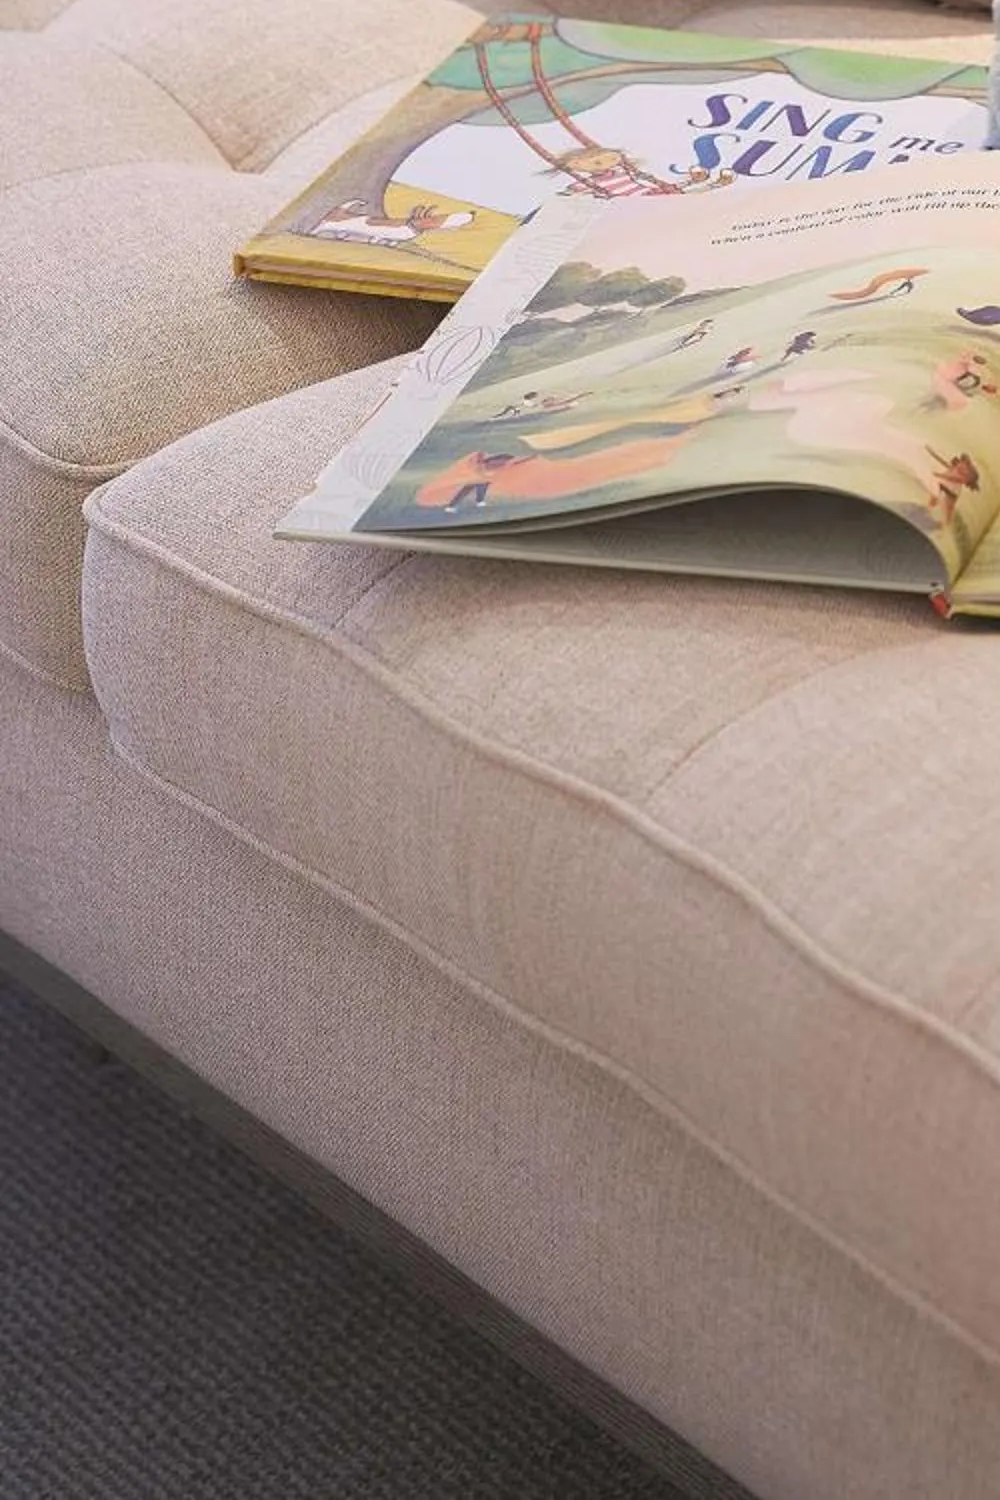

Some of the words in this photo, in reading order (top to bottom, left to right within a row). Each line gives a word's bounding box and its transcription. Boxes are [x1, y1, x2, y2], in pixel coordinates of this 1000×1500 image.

[687, 93, 884, 144] SING
[888, 135, 965, 155] me
[669, 133, 909, 181] SUM
